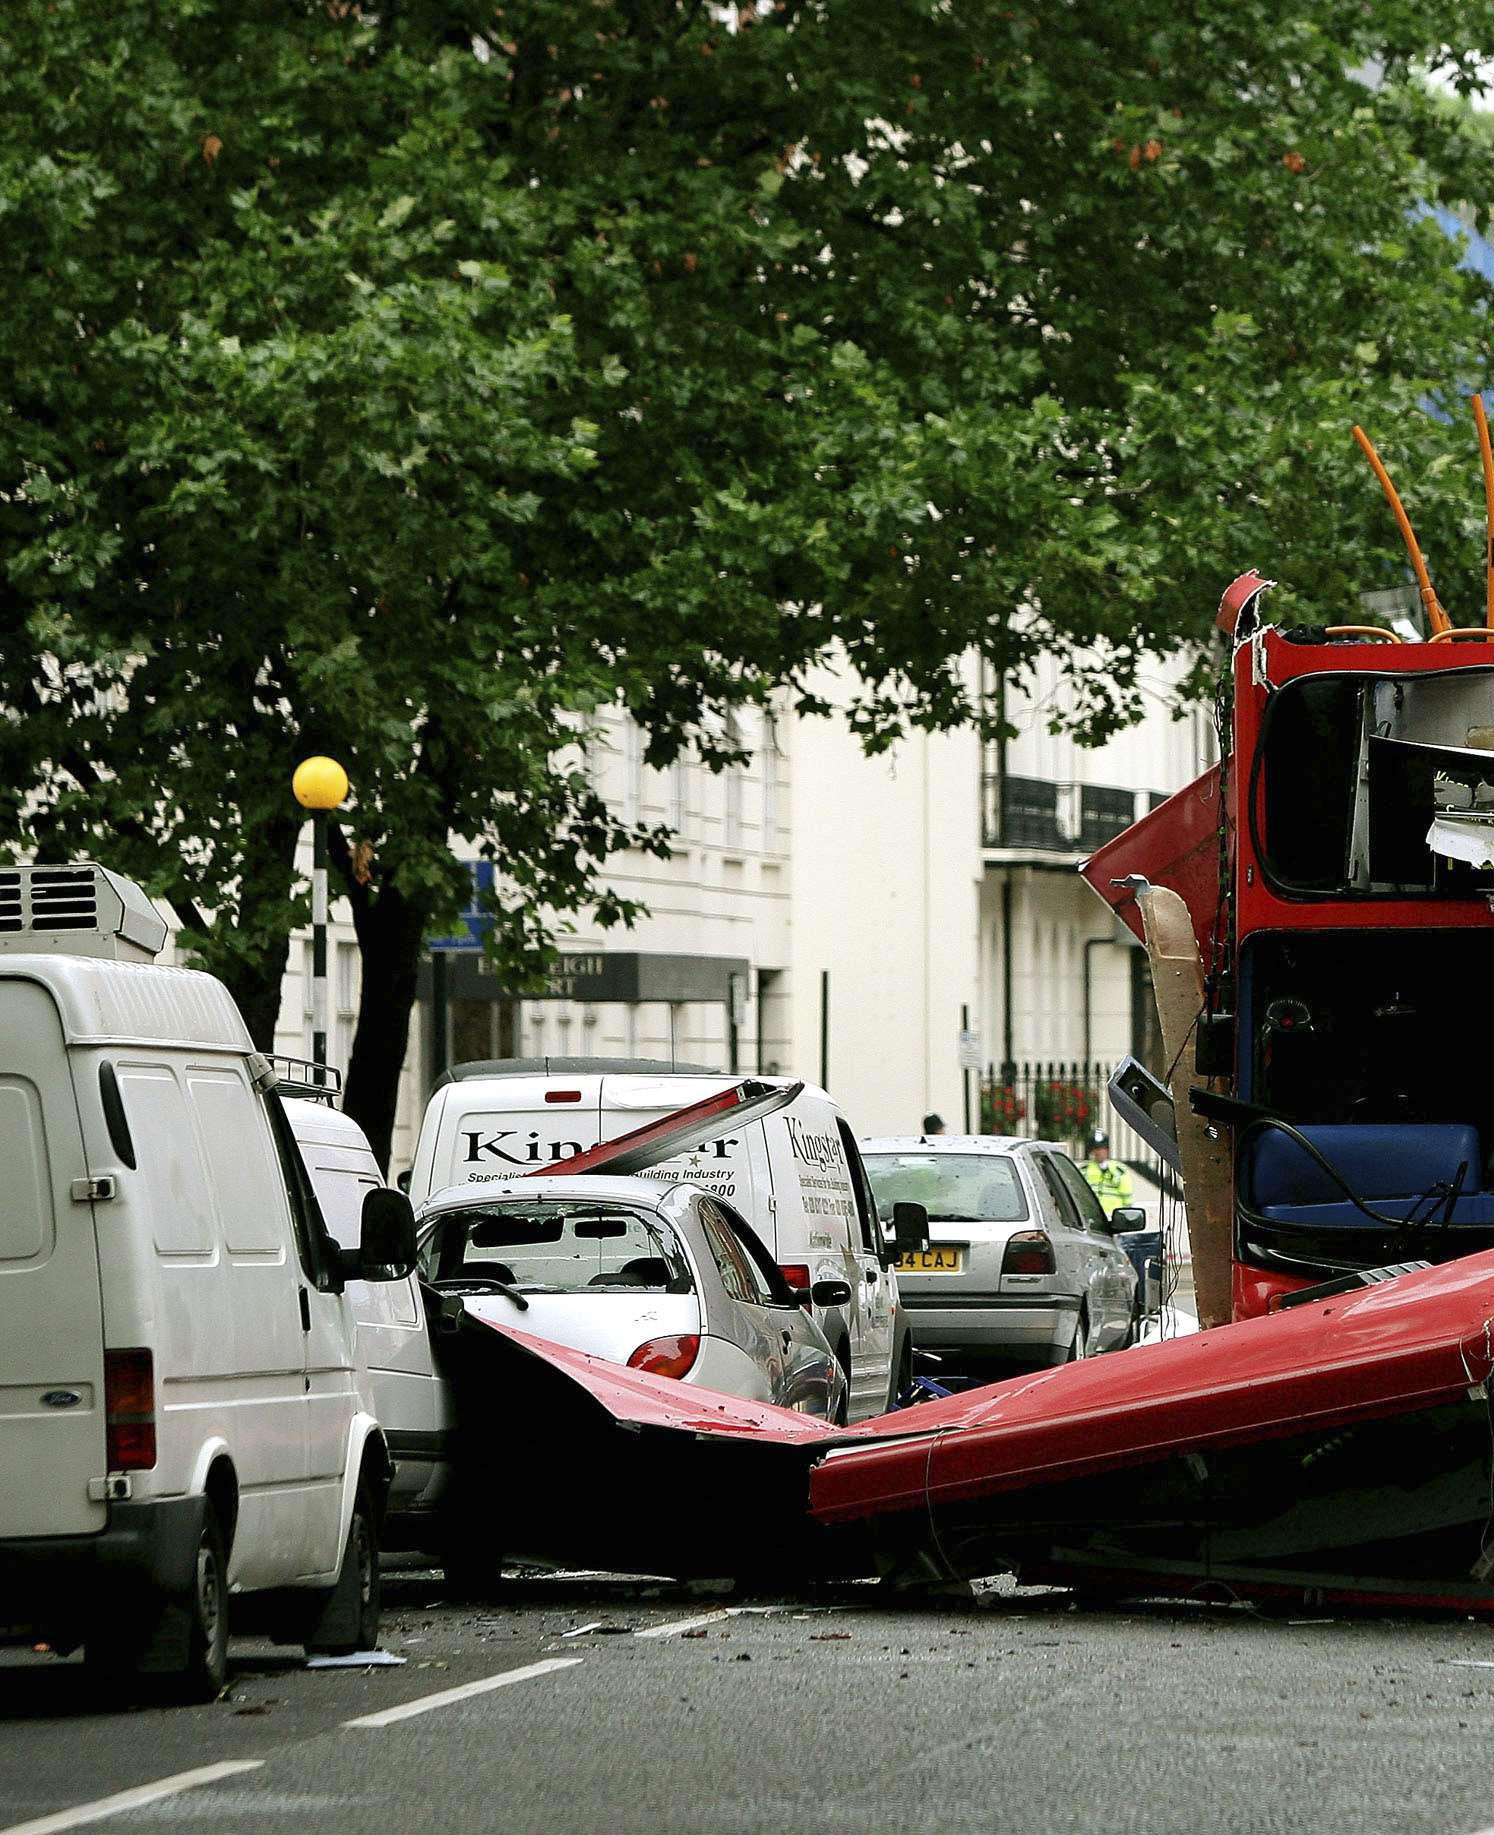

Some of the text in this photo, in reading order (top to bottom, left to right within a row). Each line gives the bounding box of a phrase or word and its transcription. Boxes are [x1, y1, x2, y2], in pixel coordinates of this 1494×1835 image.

[783, 1116, 845, 1173] Kingstar
[468, 1169, 735, 1183] Speciali uilding Industry
[704, 1184, 736, 1197] 800
[922, 1250, 958, 1269] CAJ
